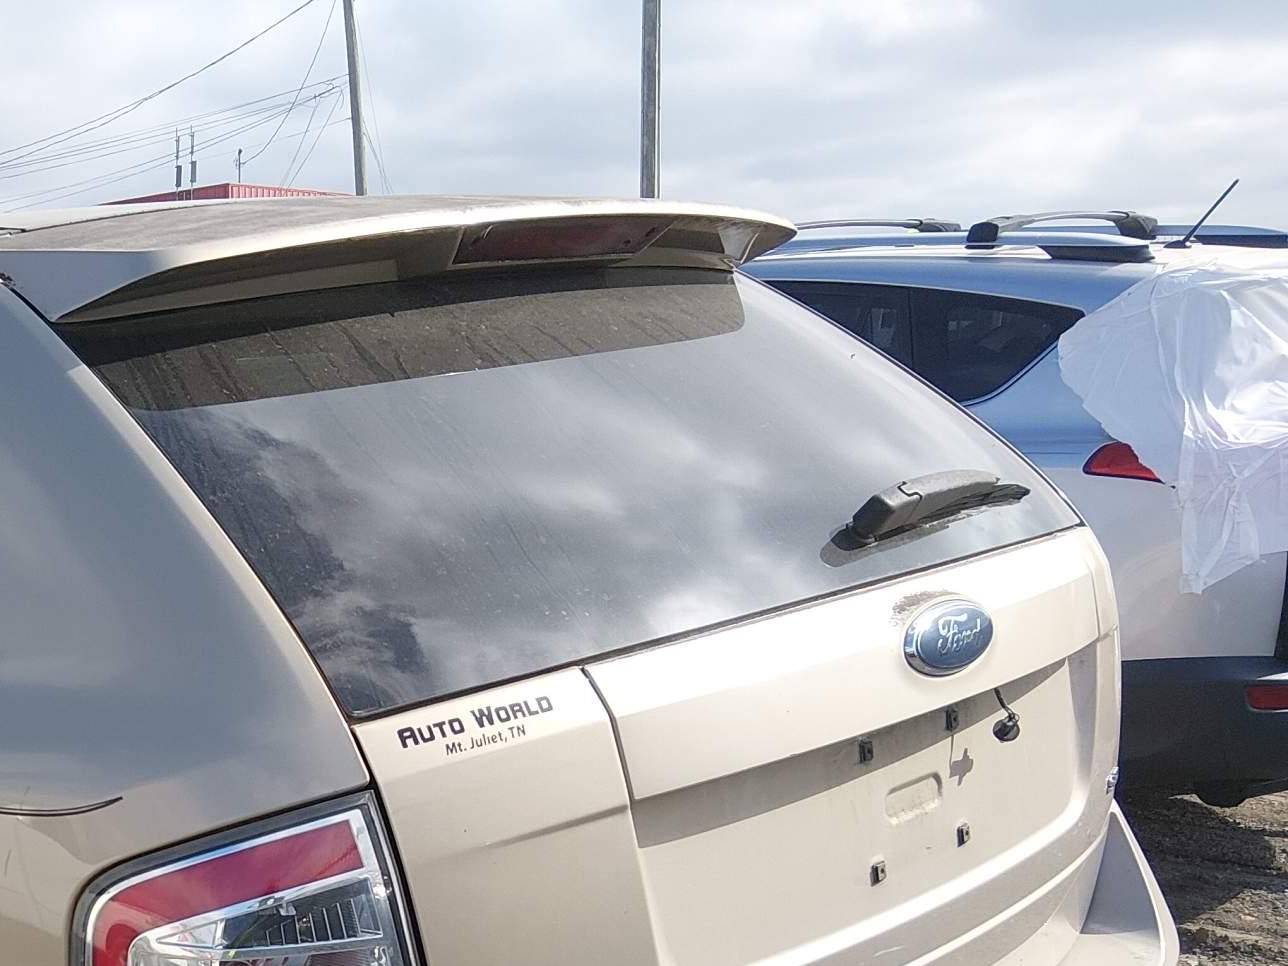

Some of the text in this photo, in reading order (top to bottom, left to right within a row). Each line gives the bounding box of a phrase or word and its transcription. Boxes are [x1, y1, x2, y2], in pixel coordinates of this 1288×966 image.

[937, 613, 981, 654] Ford
[445, 724, 526, 756] Mt. Juliet, TN
